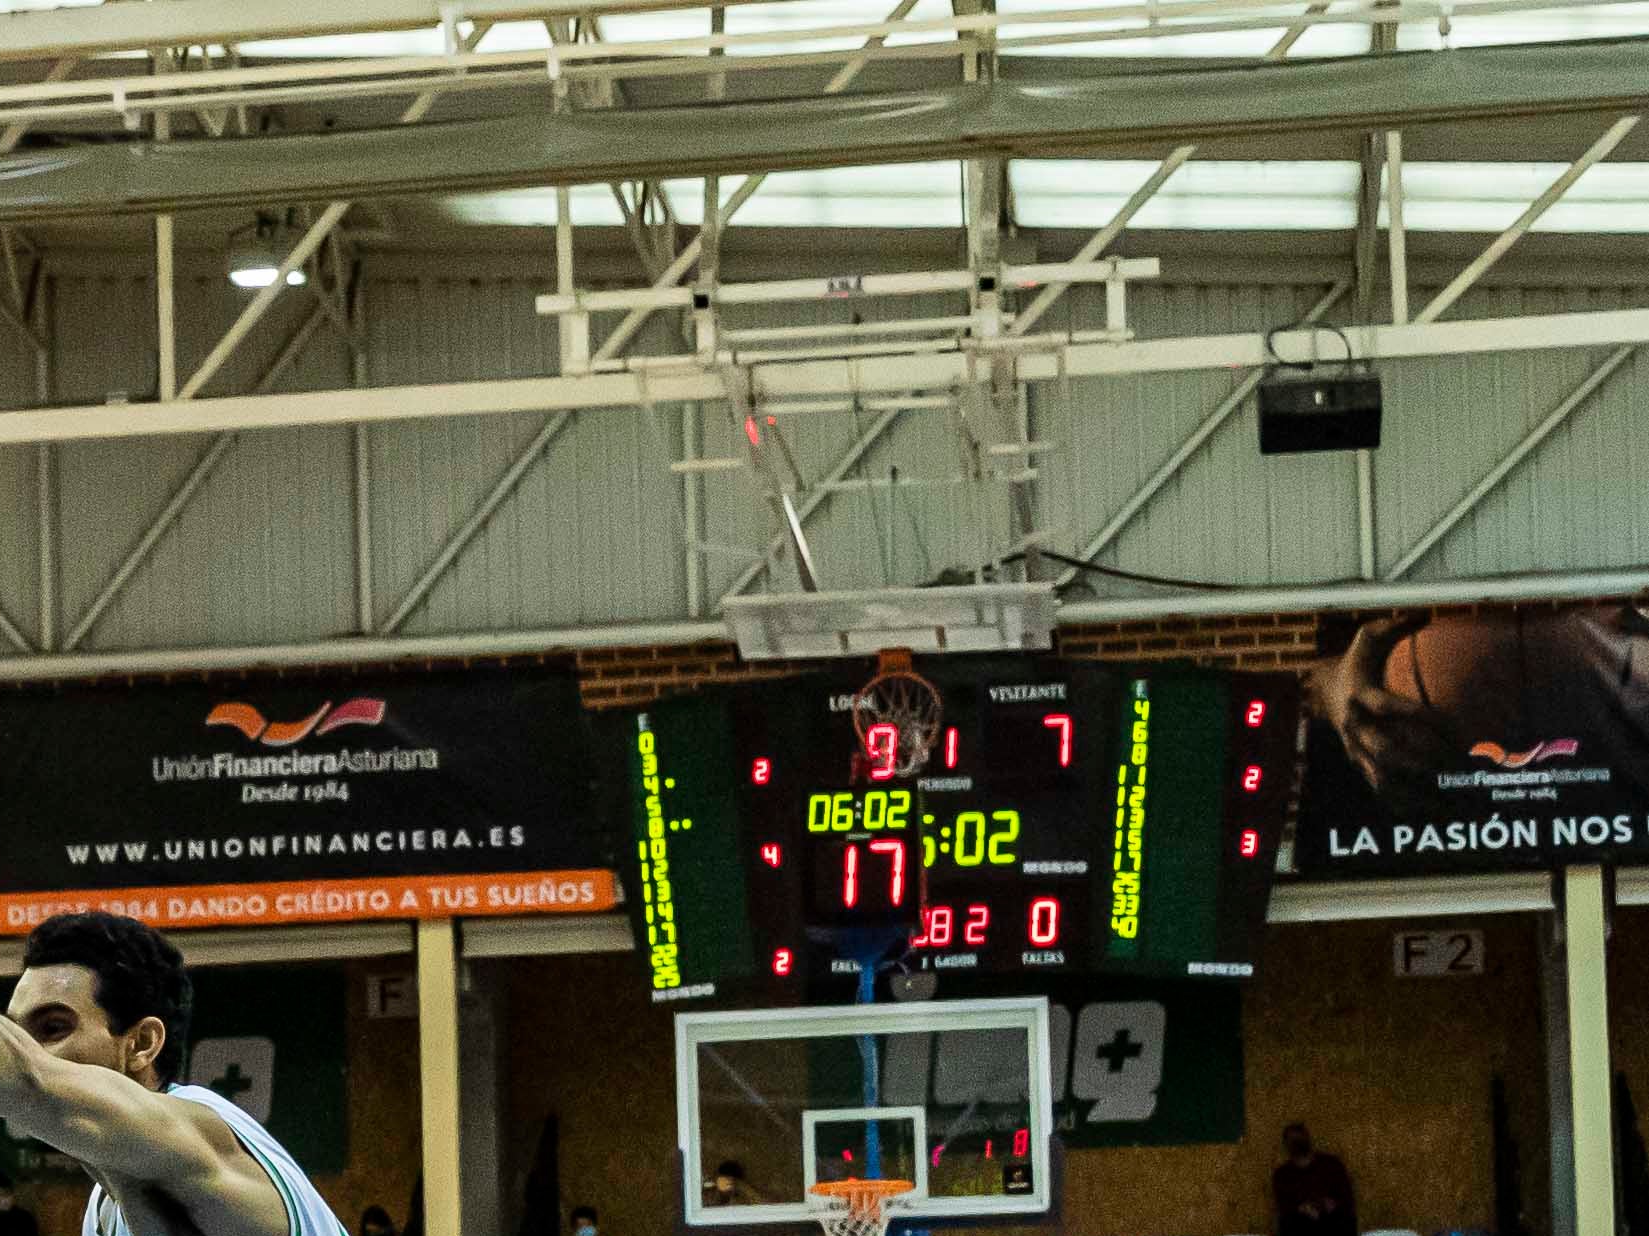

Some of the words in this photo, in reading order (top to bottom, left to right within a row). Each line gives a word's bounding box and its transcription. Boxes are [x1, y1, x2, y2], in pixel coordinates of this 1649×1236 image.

[1247, 700, 1266, 727] 2
[865, 722, 899, 781] 9
[944, 726, 960, 770] 1
[1042, 712, 1073, 769] 7
[152, 747, 438, 782] UniónFinancieraAsturiana
[753, 758, 770, 784] 2
[1242, 765, 1262, 793] 2
[304, 781, 349, 801] 1984
[807, 790, 911, 833] 06:02
[66, 825, 525, 865] WWW.UNIONFINANCIERA.ES
[1240, 829, 1259, 857] 3
[1328, 828, 1379, 857] LA
[1393, 813, 1538, 853] PASIÓN
[1552, 815, 1635, 846] NOS
[762, 843, 781, 868] 4
[842, 837, 907, 908] 17
[168, 894, 268, 919] DANDO
[275, 882, 393, 915] CRÉDITO
[399, 888, 422, 911] A
[427, 884, 480, 909] TUS
[488, 877, 595, 907] SUEÑOS
[964, 903, 989, 946] 2
[1028, 896, 1060, 947] 0
[773, 949, 793, 975] 2
[1402, 935, 1429, 972] F
[1447, 934, 1474, 970] 2
